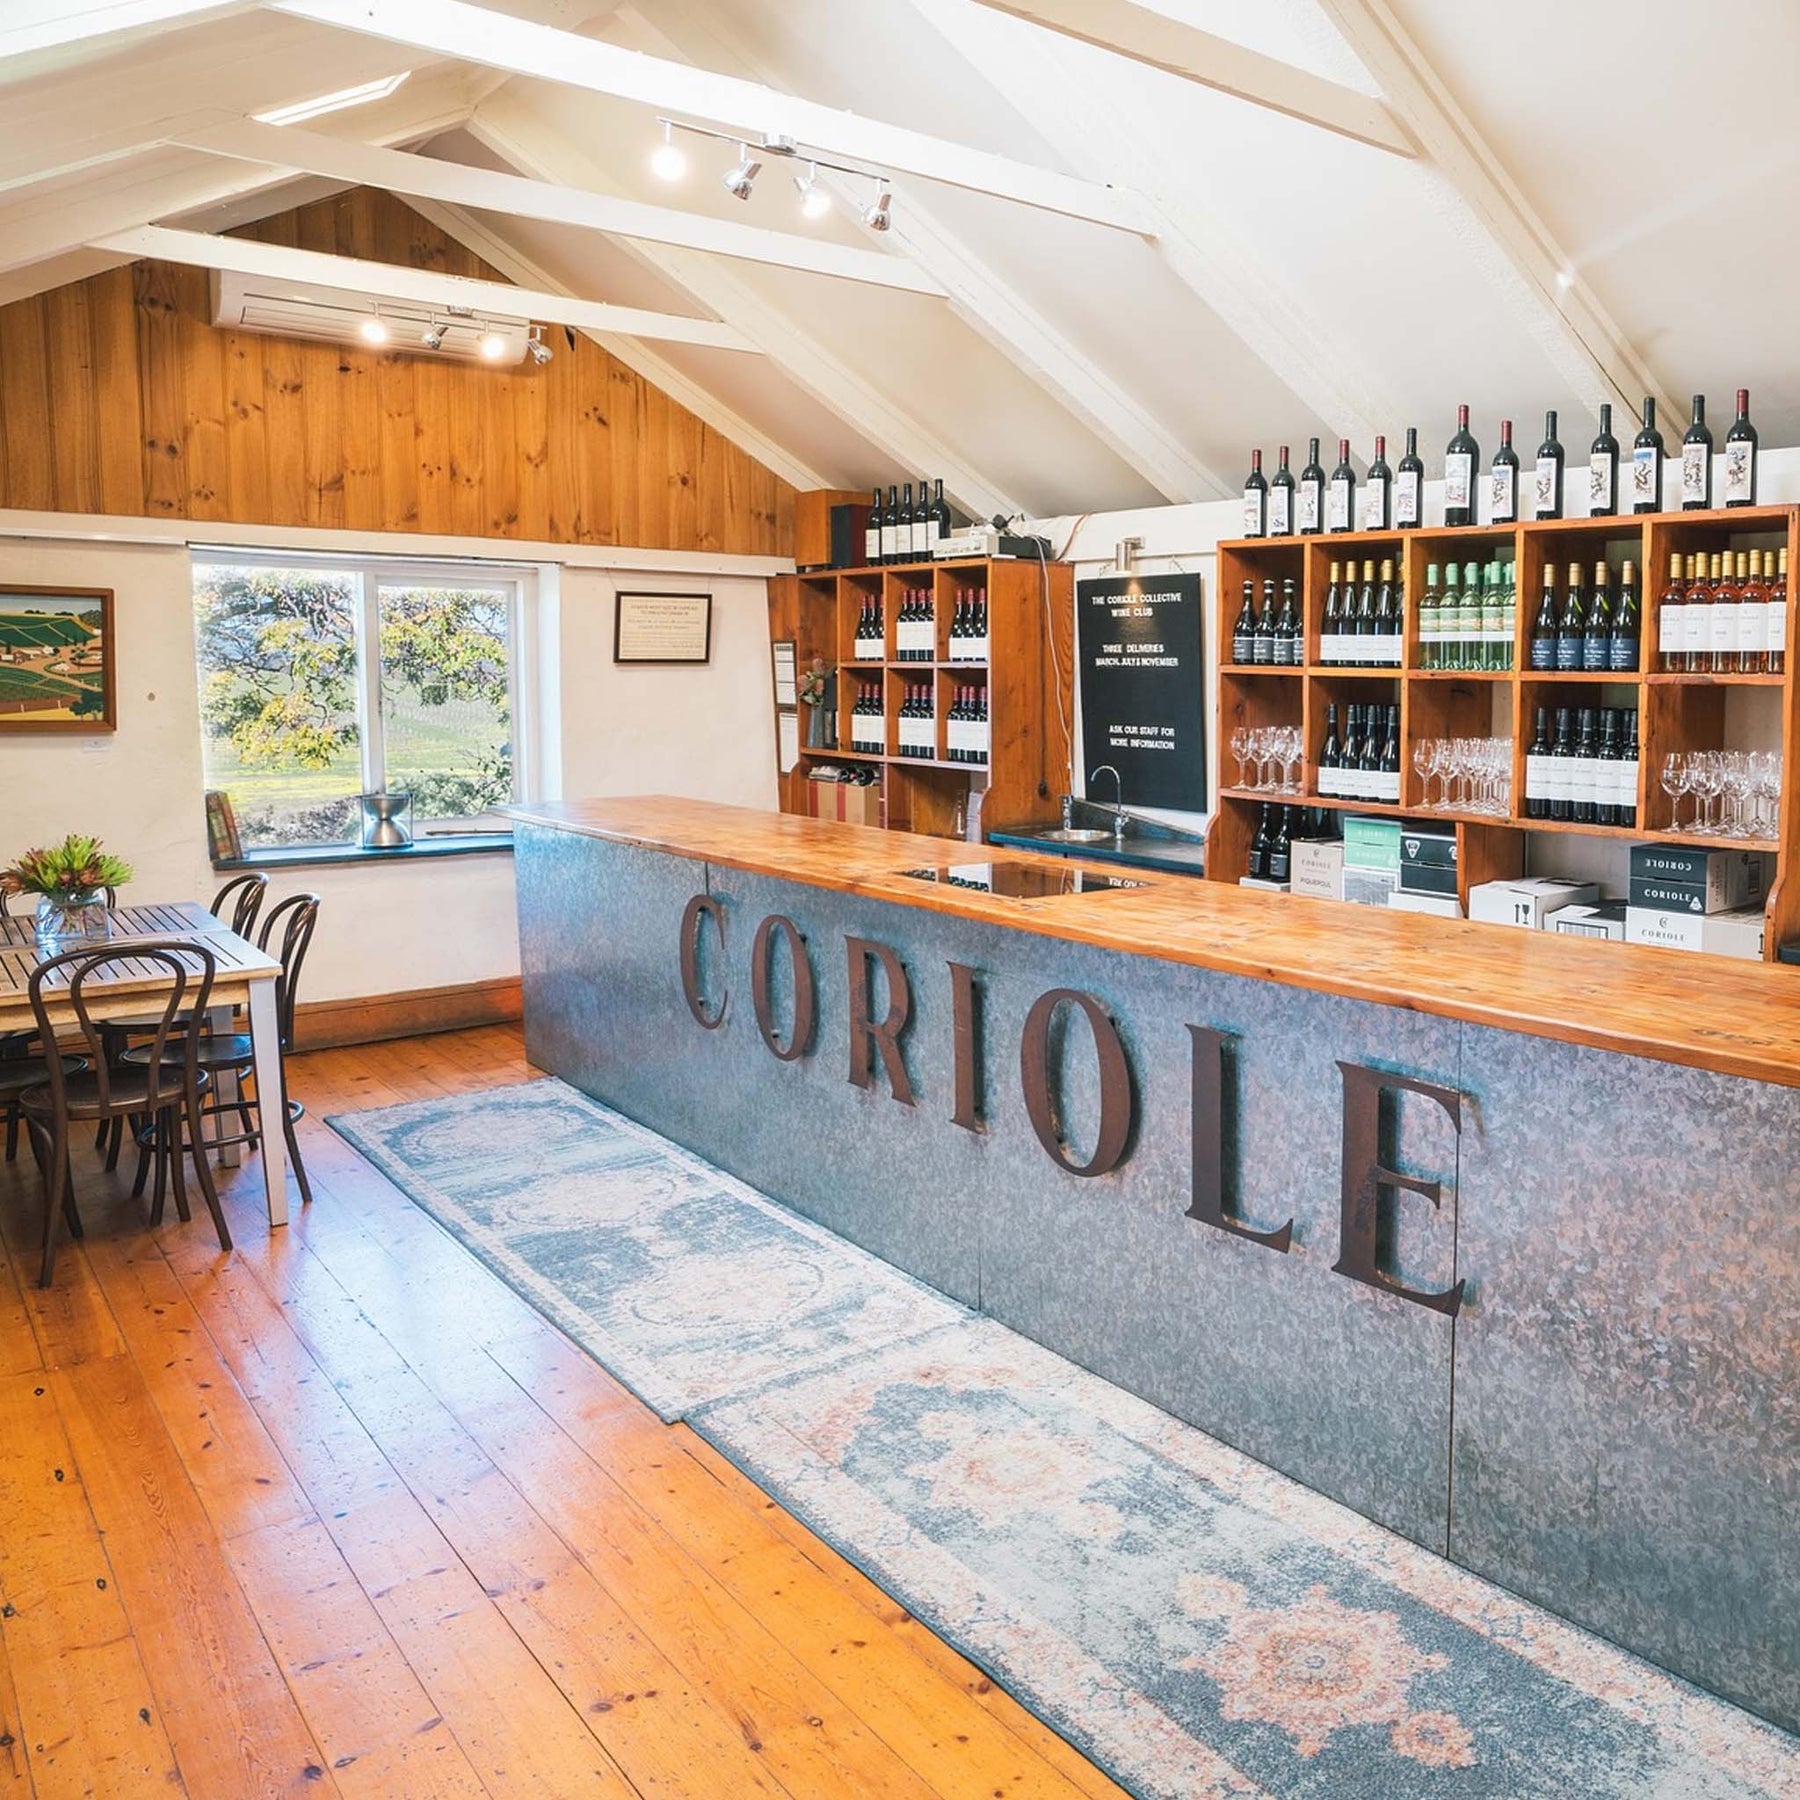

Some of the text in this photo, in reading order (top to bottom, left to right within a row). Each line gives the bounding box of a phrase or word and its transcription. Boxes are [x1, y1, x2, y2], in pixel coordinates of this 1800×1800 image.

[1092, 592, 1182, 605] THE CORIOLE COLLECTIVE
[1111, 607, 1153, 617] WINE CLUB
[1102, 644, 1164, 653] THREE DELIVERIES
[1141, 657, 1179, 667] NOVEMBER
[1109, 725, 1175, 737] ASK OUR STAFF FOR
[1110, 738, 1175, 750] MORE INFORMATION
[1645, 858, 1692, 871] CORIOLE
[1644, 888, 1691, 902] CORIOLE
[680, 893, 1466, 1318] CORIOLE
